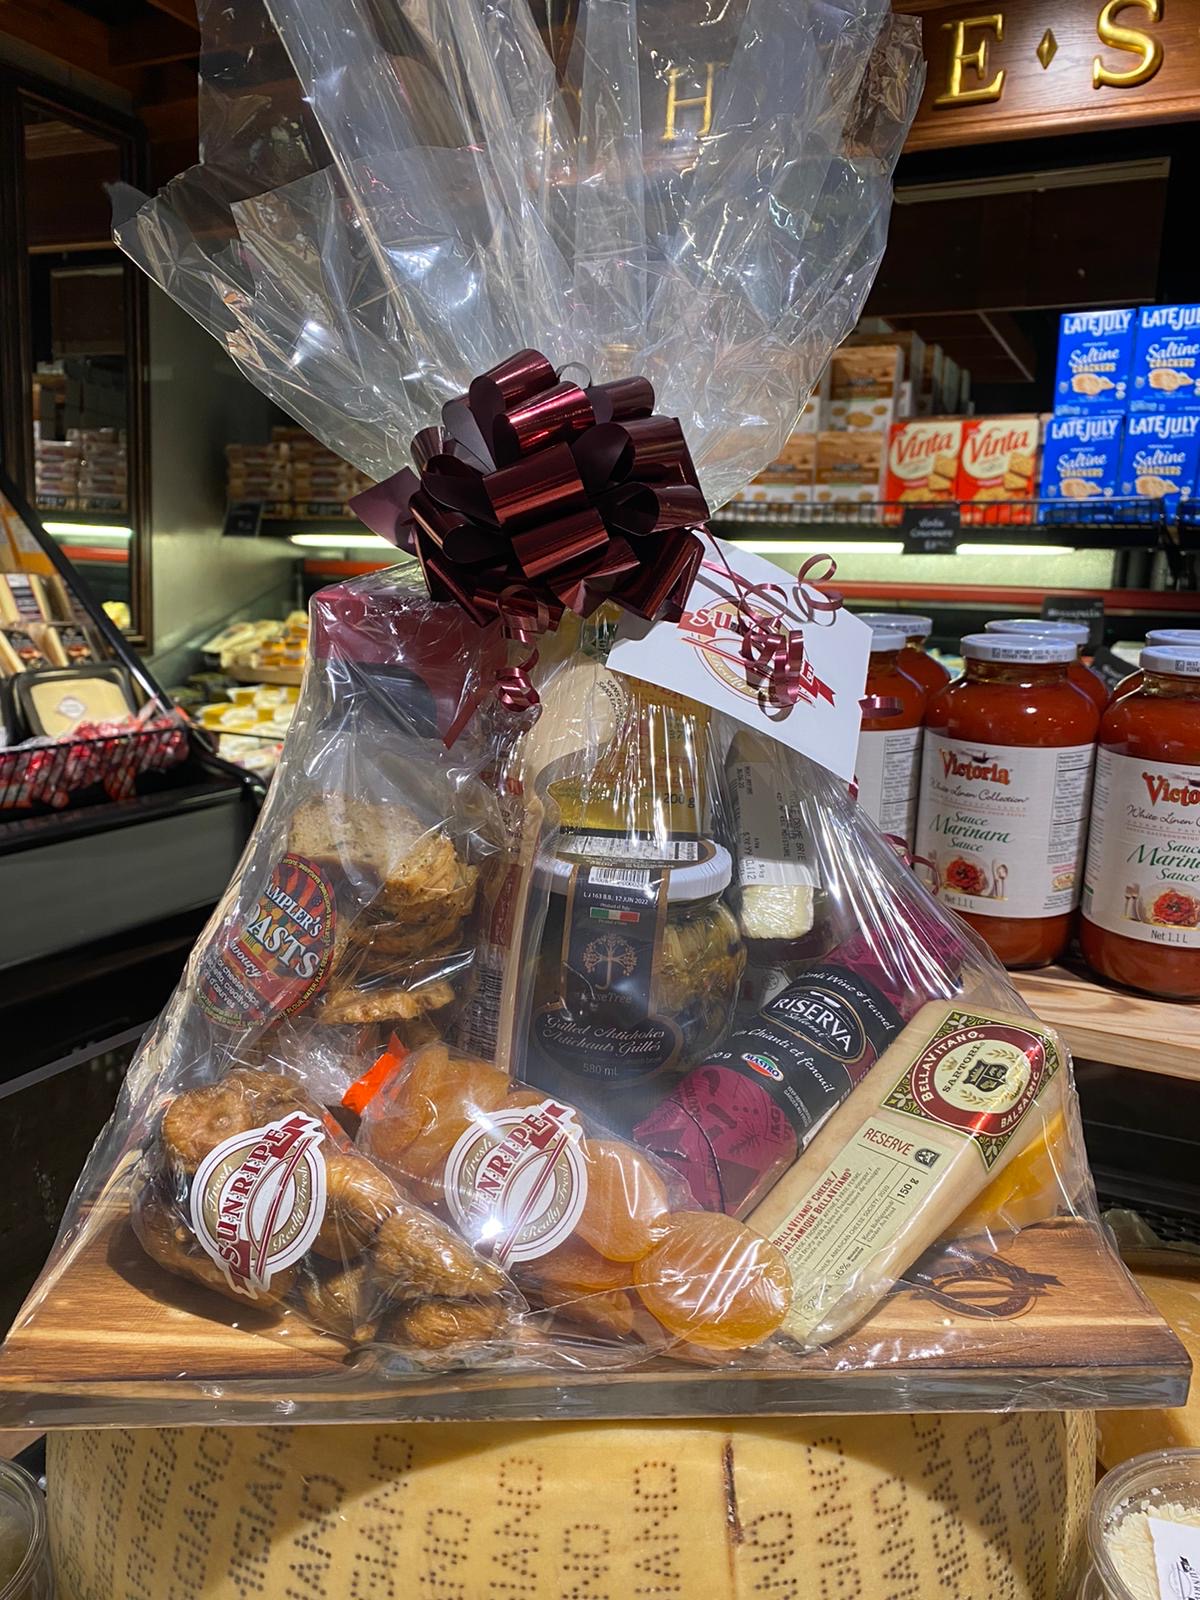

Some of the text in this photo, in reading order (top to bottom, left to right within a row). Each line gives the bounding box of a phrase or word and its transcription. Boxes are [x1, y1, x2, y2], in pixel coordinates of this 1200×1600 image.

[1068, 347, 1120, 366] Saltine
[893, 429, 953, 463] Vinta
[969, 428, 1029, 463] Vinta
[1057, 451, 1107, 471] Saltine
[1133, 449, 1187, 469] Saltine
[939, 748, 1011, 785] Victoria
[951, 811, 988, 826] Sauce
[1127, 804, 1194, 825] White Linen
[929, 814, 1014, 844] Marinara
[947, 837, 984, 852] Sauce
[635, 897, 648, 905] 2022
[1151, 929, 1166, 941] Net
[1182, 933, 1188, 944] L
[827, 974, 856, 991] Wine
[863, 997, 896, 1031] Fennel
[546, 1013, 665, 1041] Grilled Artichokes
[772, 997, 852, 1053] RISERVA
[790, 1047, 805, 1060] et
[918, 1030, 979, 1102] BELLAVITANO
[583, 1063, 601, 1074] 580
[744, 1054, 781, 1079] MASTRO
[797, 1056, 836, 1094] fenouil
[942, 1043, 981, 1093] SARTORI
[1000, 1071, 1040, 1129] BALSAMIC
[863, 1127, 914, 1156] RESERVE
[812, 1177, 833, 1202] CHEESE
[896, 1181, 913, 1200] 150
